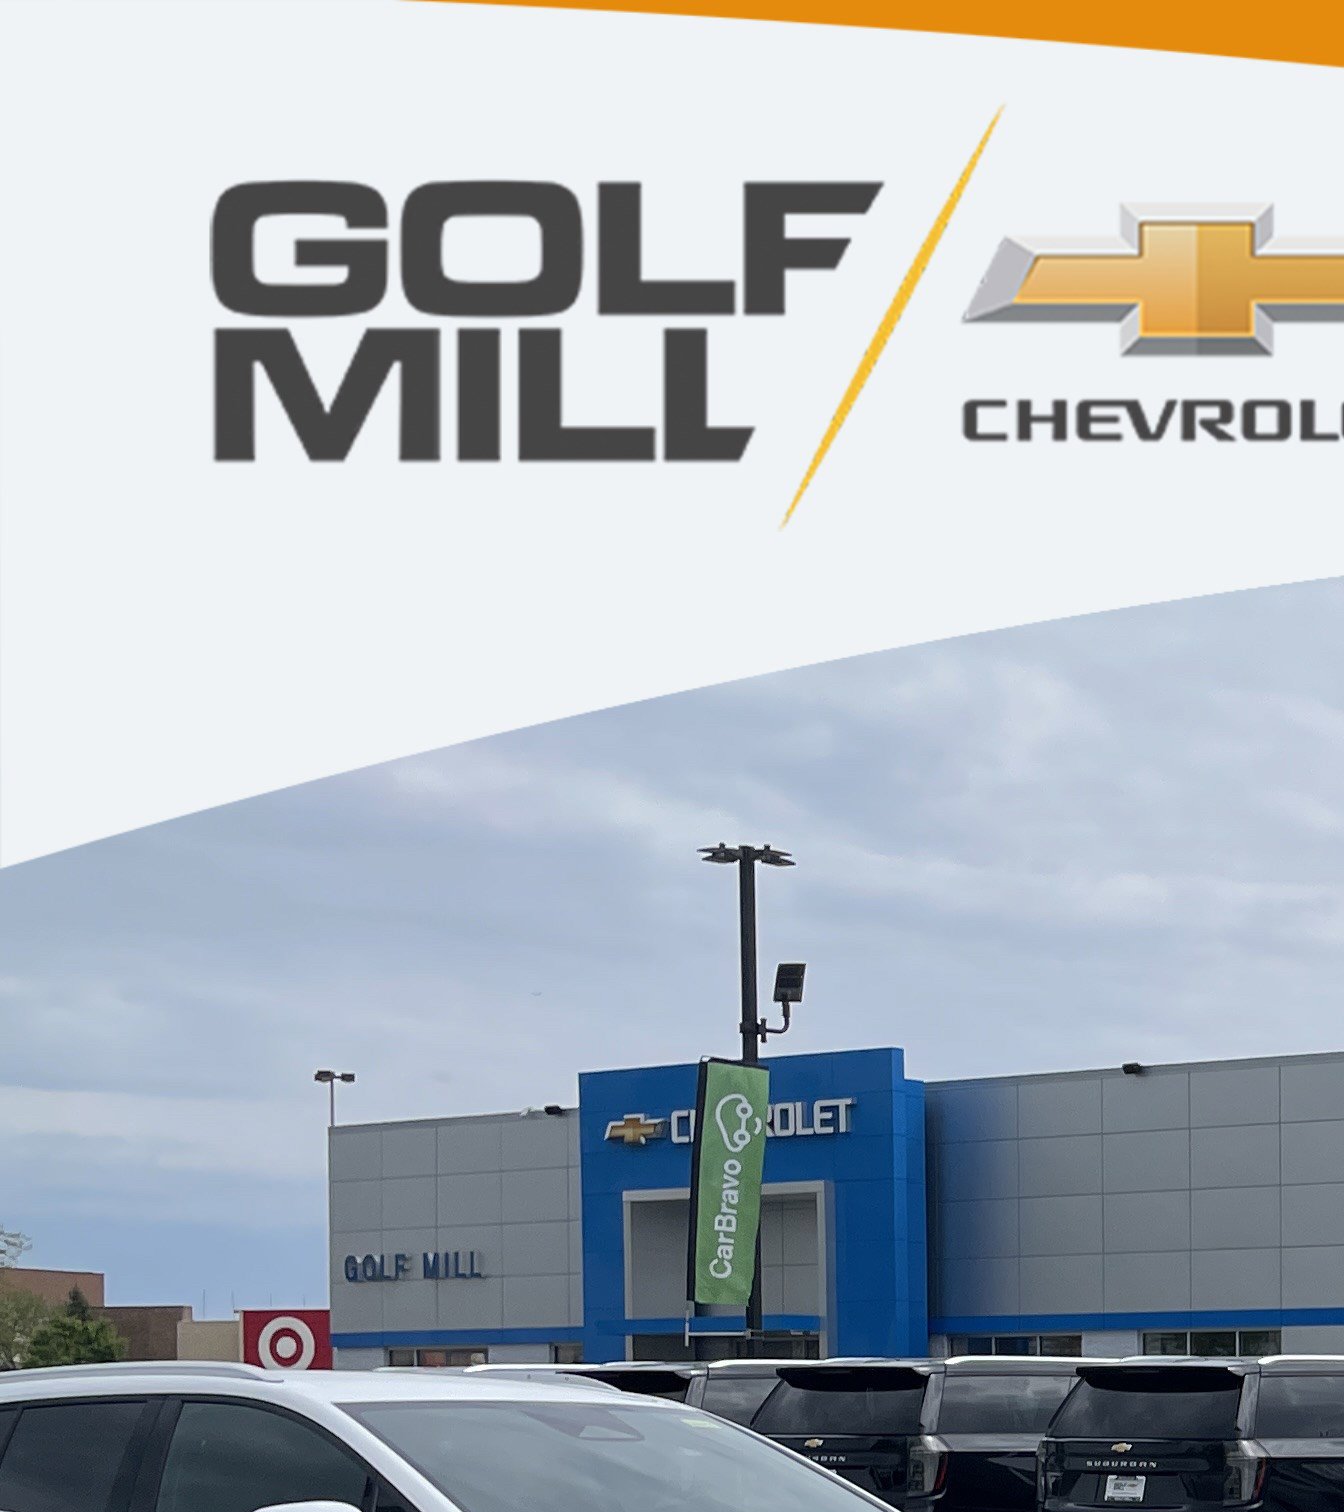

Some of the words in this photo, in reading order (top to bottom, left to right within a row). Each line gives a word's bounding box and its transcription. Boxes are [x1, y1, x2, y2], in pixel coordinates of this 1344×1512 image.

[708, 1158, 742, 1280] CarBravo
[344, 1254, 410, 1282] GOLF
[422, 1250, 483, 1279] MILL
